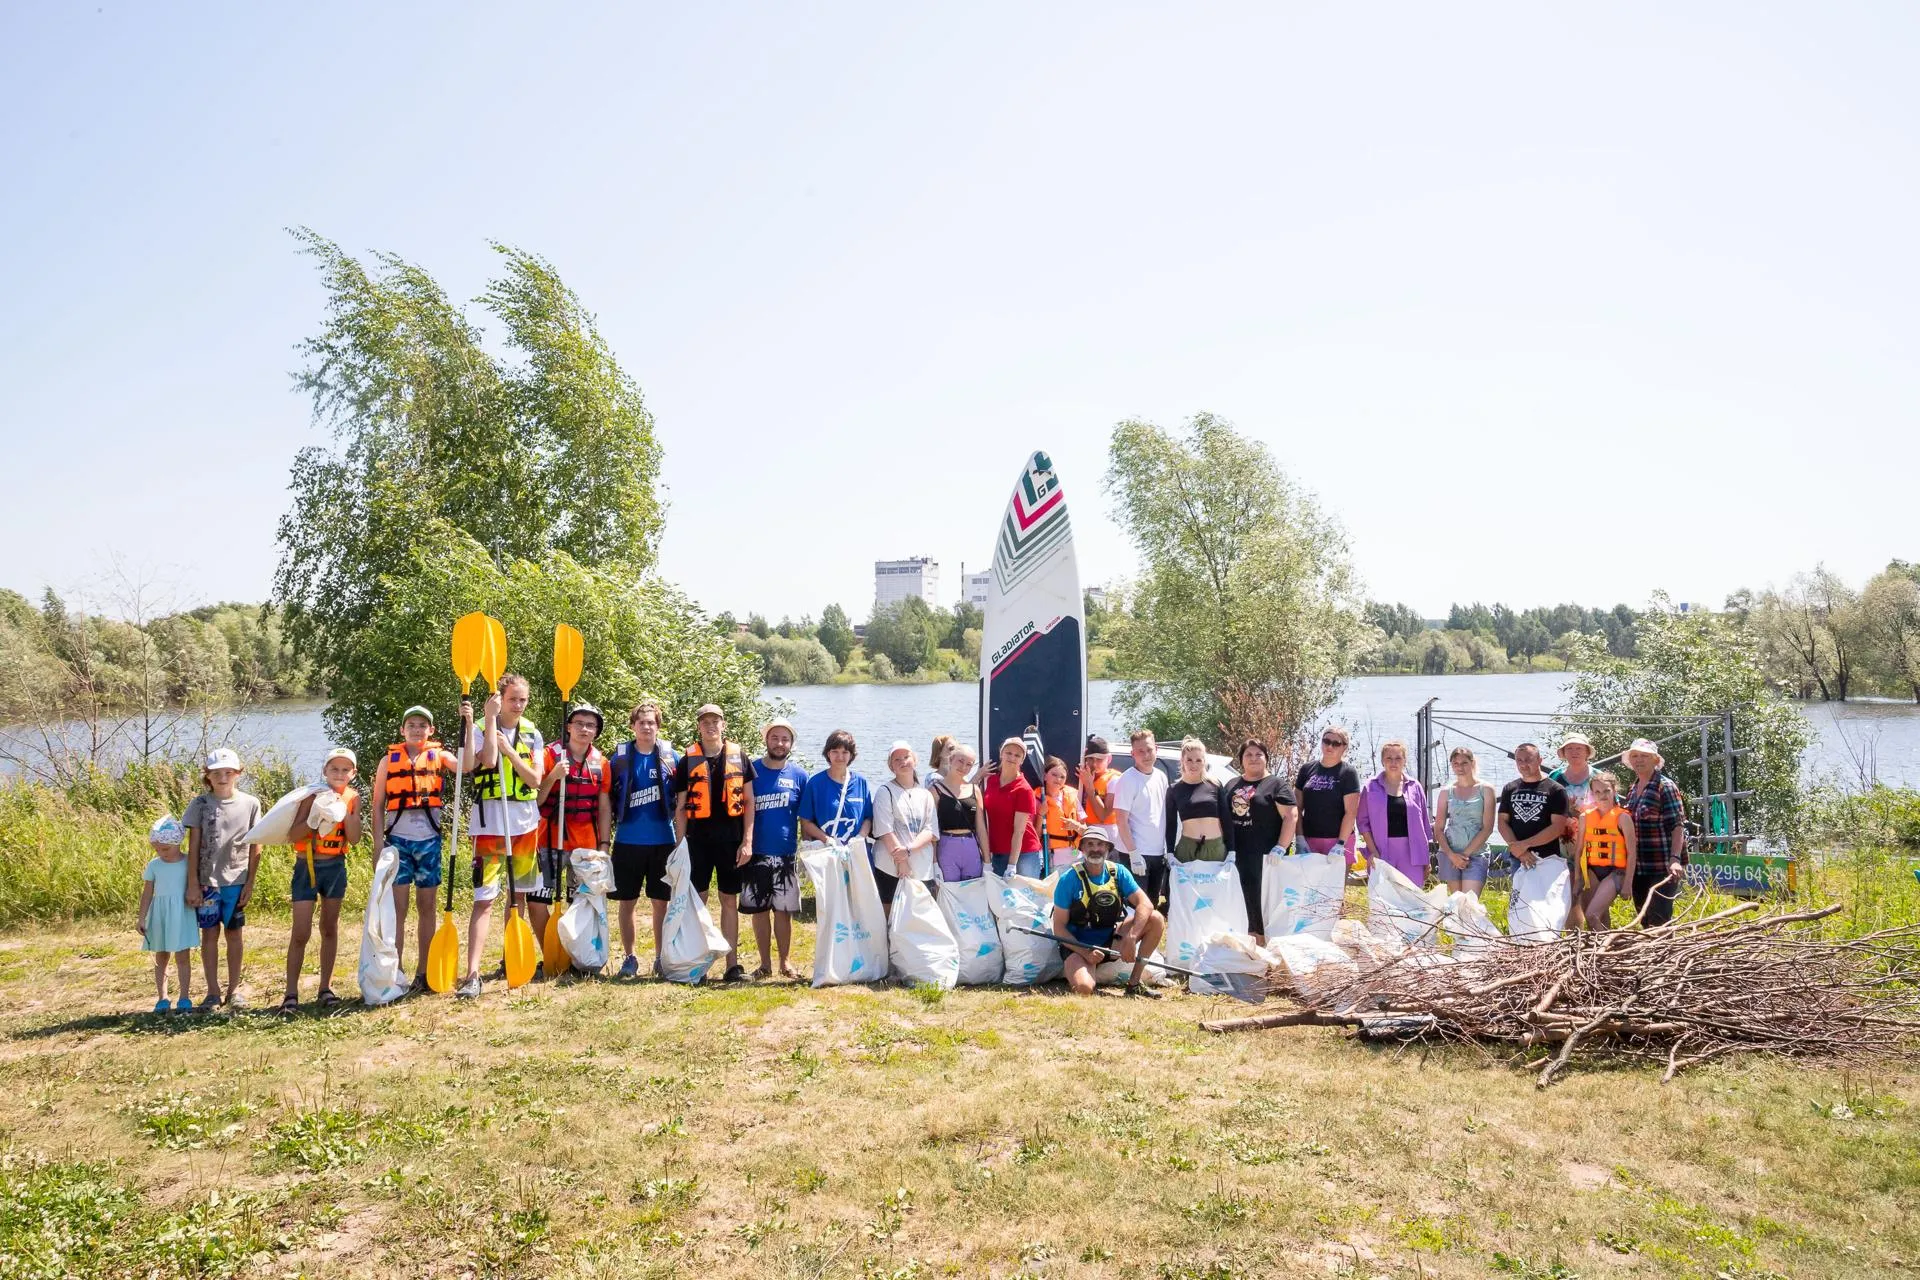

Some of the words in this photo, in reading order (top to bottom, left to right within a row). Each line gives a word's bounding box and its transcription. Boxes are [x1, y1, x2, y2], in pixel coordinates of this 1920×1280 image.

[1510, 792, 1548, 802] EXTREME
[1686, 864, 1711, 880] 929
[1715, 865, 1741, 881] 295
[1744, 866, 1762, 881] 64
